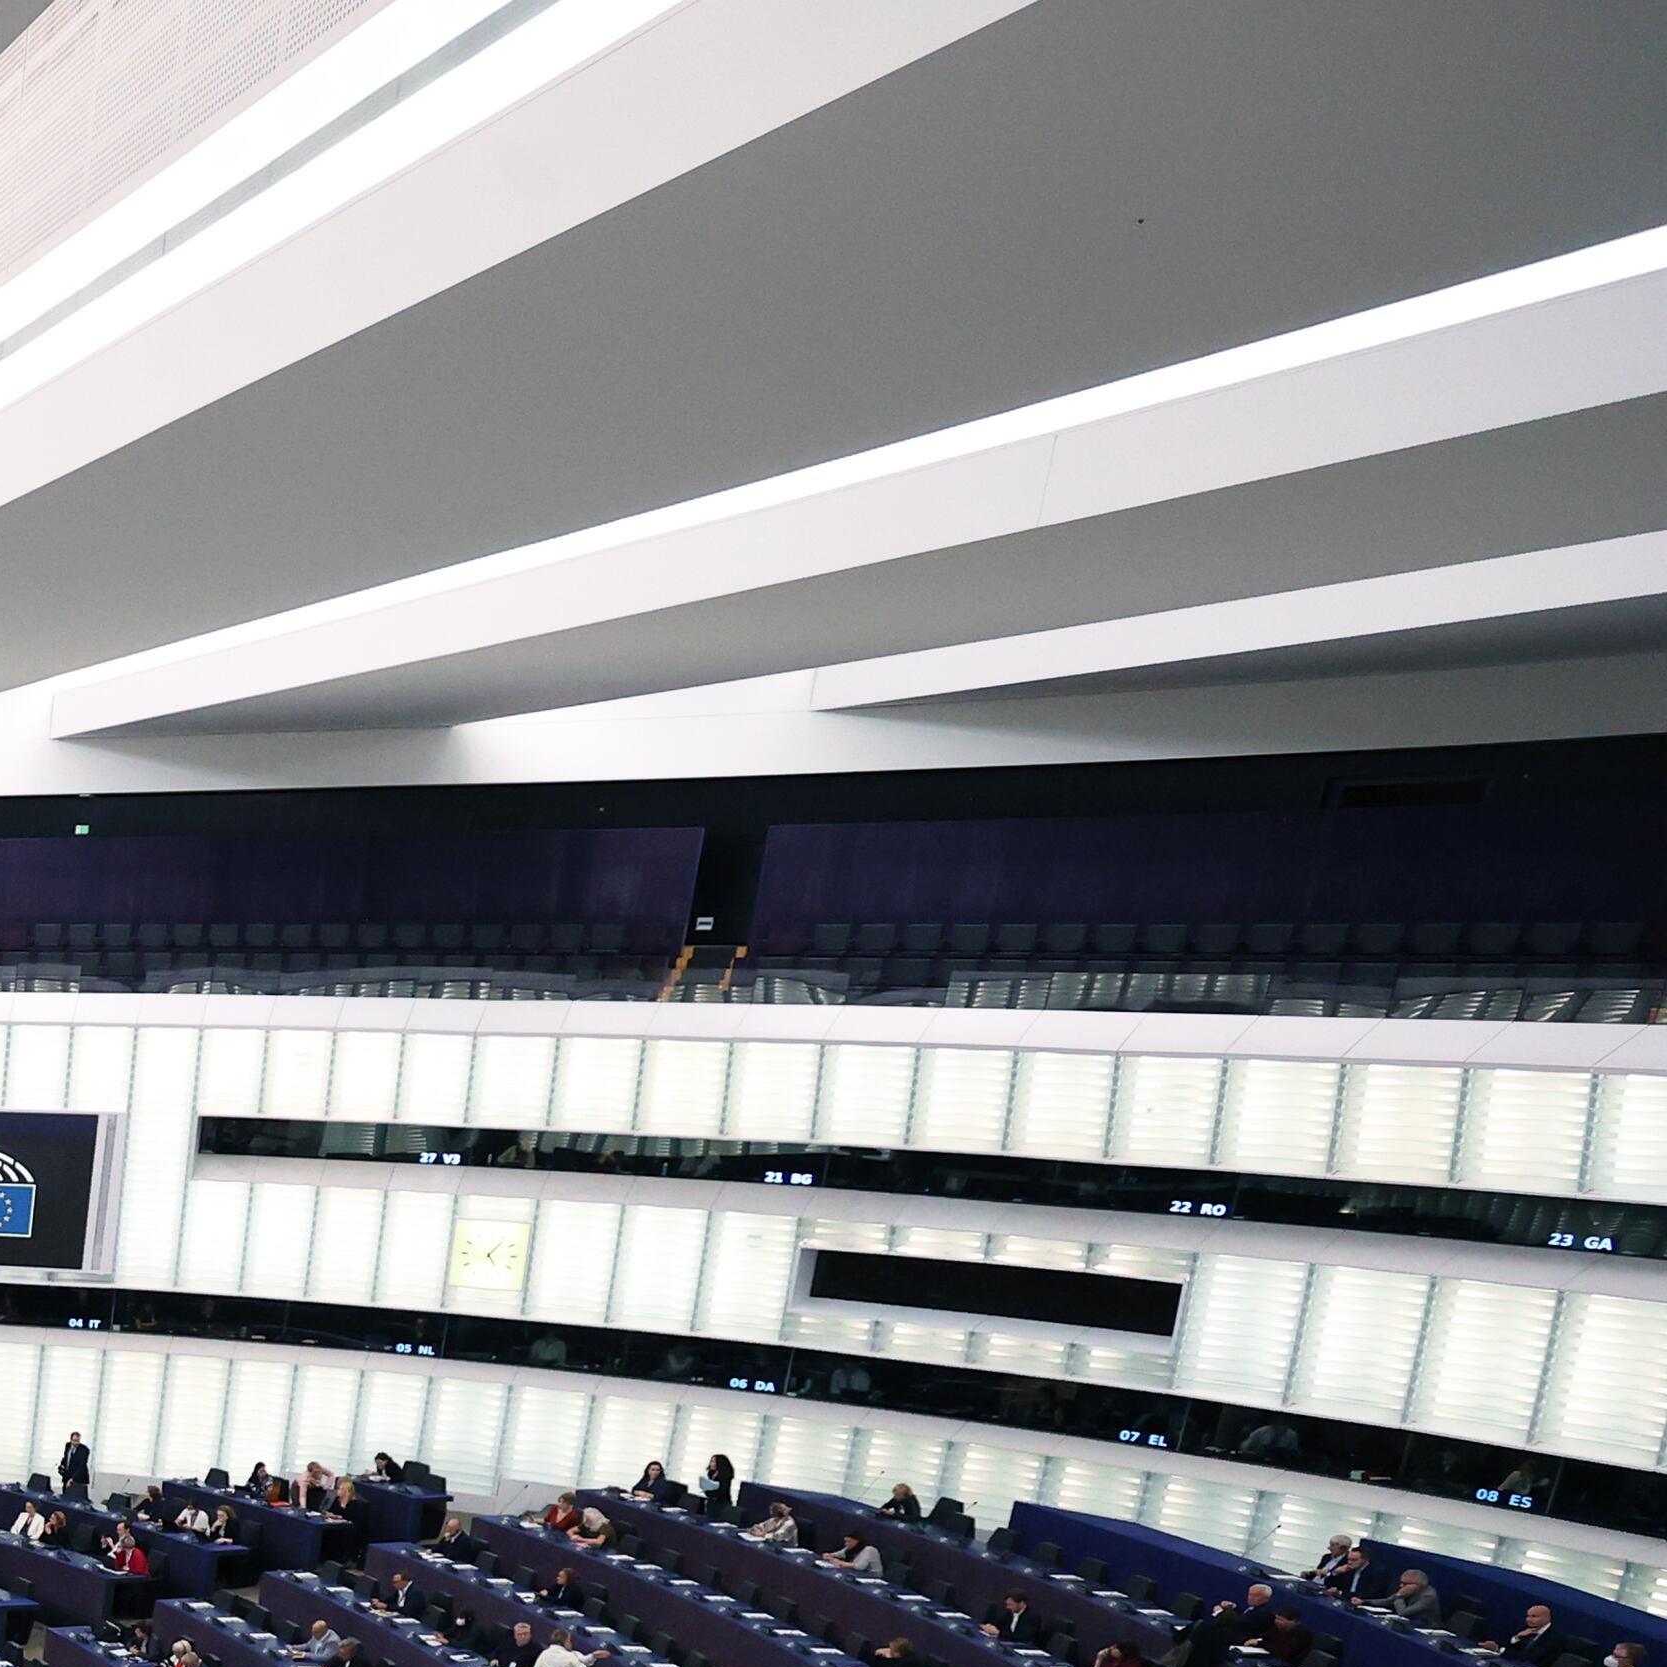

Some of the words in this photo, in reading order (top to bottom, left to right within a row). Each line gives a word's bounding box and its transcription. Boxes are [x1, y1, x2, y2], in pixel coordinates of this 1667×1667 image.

[419, 1151, 438, 1164] 27
[442, 1153, 461, 1165] V3
[763, 1171, 784, 1184] 21
[1169, 1200, 1193, 1214] 22
[1199, 1202, 1227, 1217] RO
[1547, 1232, 1575, 1247] 23
[1583, 1236, 1613, 1251] GA
[68, 1318, 84, 1328] 04
[88, 1319, 102, 1329] IT
[395, 1342, 413, 1354] 05
[417, 1344, 436, 1356] NL
[754, 1380, 776, 1393] DA
[1119, 1429, 1141, 1442] 07
[1147, 1434, 1168, 1447] EL
[1475, 1488, 1500, 1502] 08
[1508, 1494, 1533, 1509] ES
